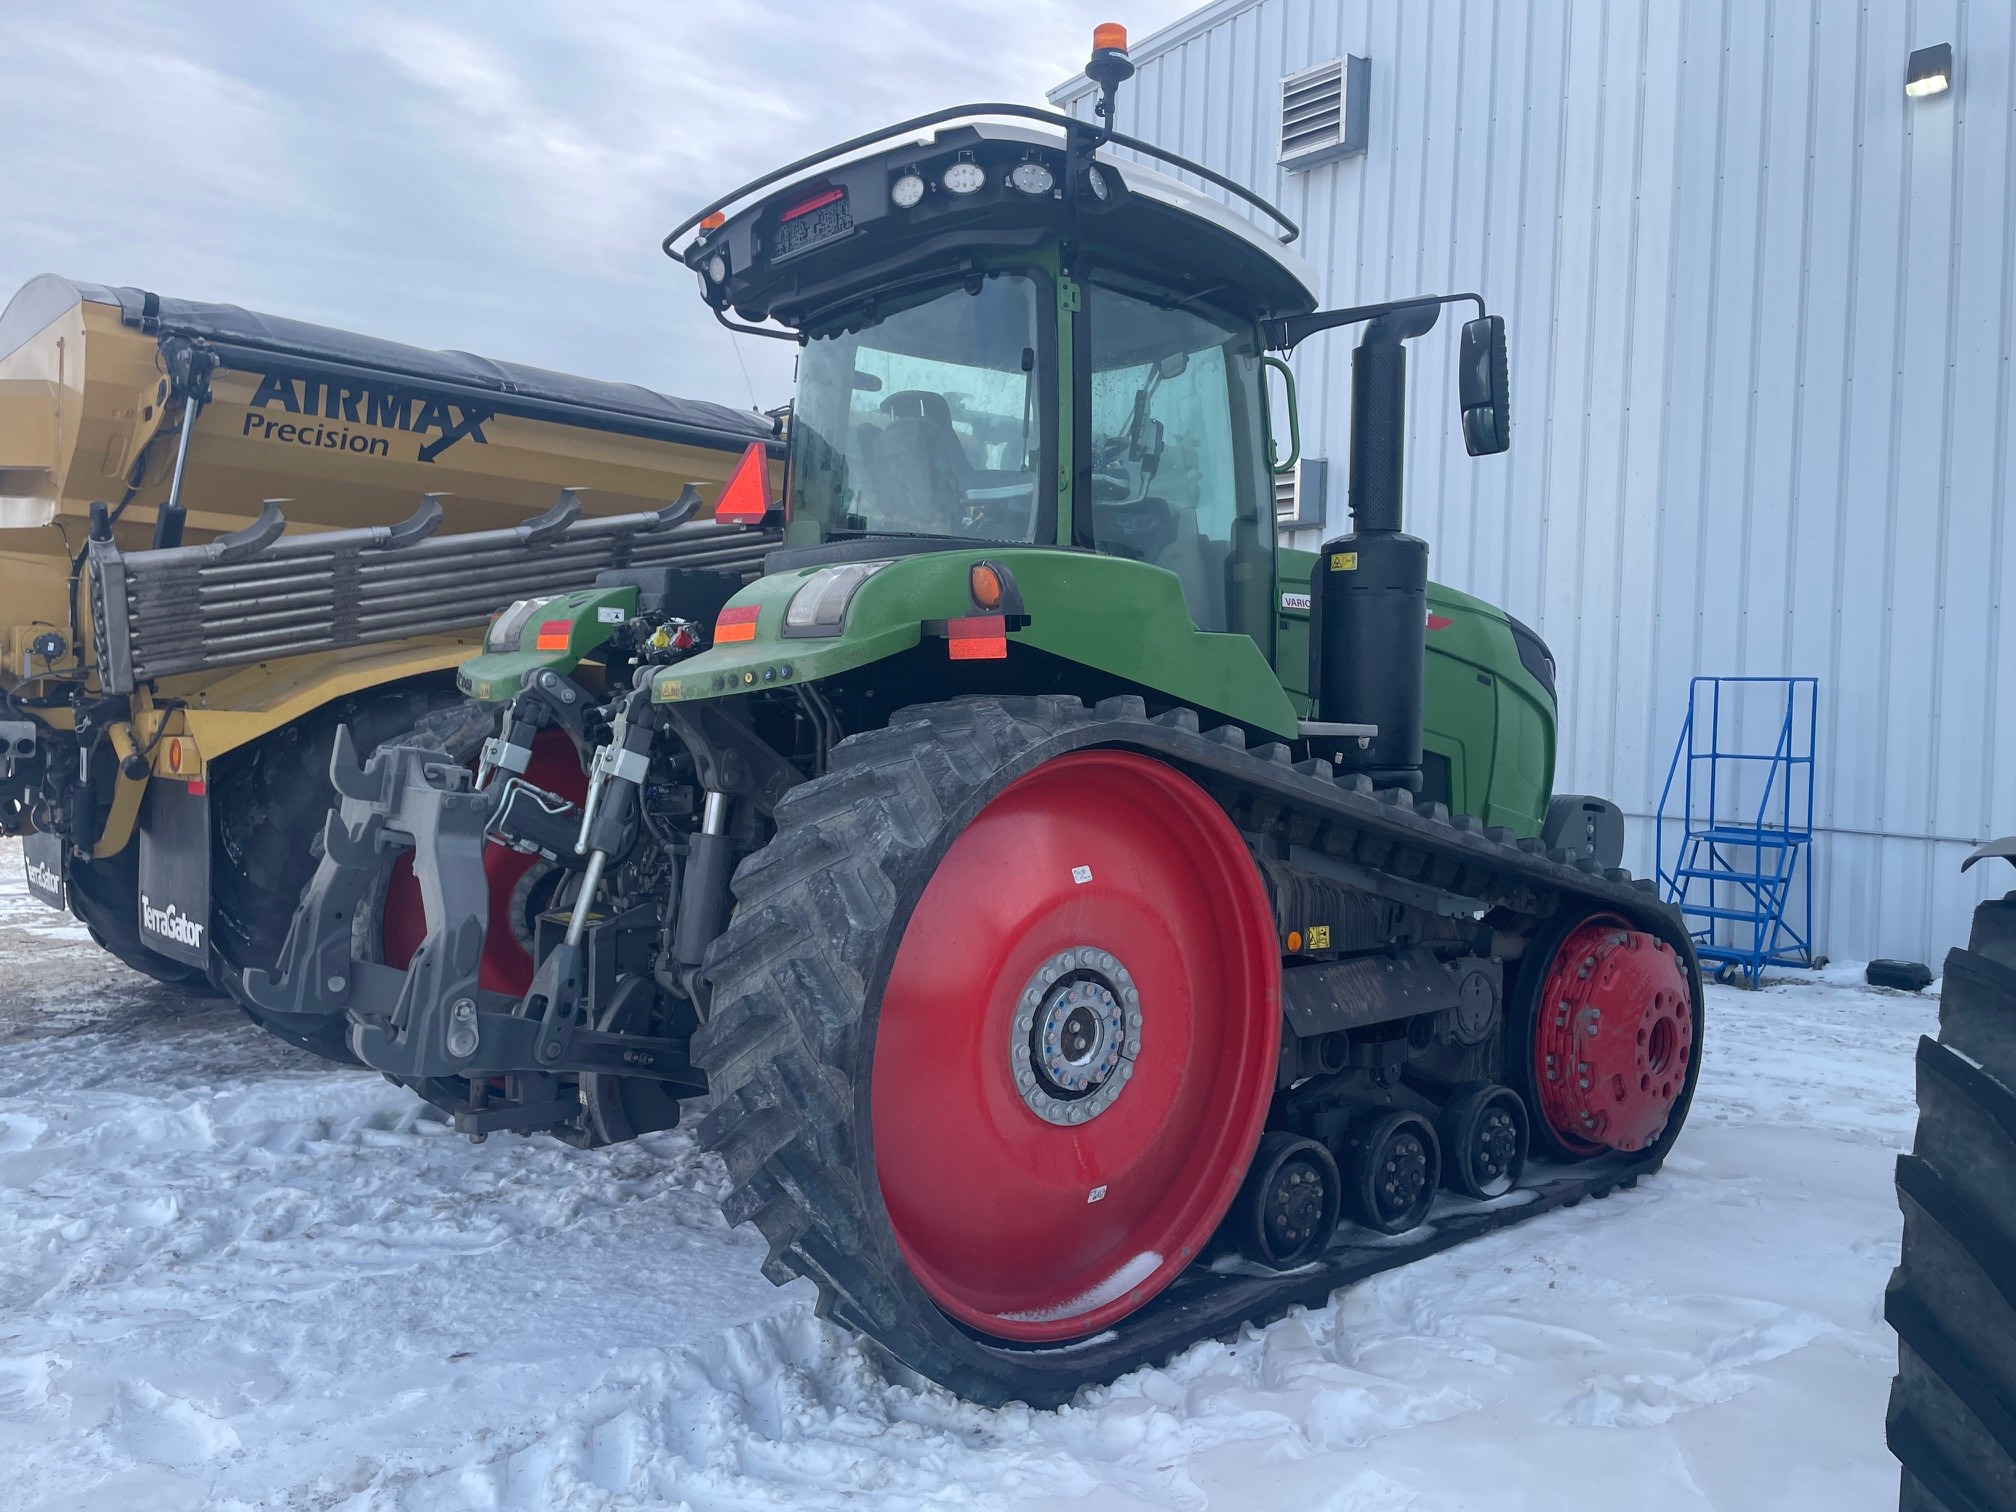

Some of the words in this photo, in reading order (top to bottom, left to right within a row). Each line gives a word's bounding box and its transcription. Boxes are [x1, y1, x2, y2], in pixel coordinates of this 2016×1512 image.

[243, 412, 390, 456] Precision
[250, 373, 495, 463] AIRMAX
[25, 856, 60, 894] TerraGator
[141, 894, 204, 948] TerraGator
